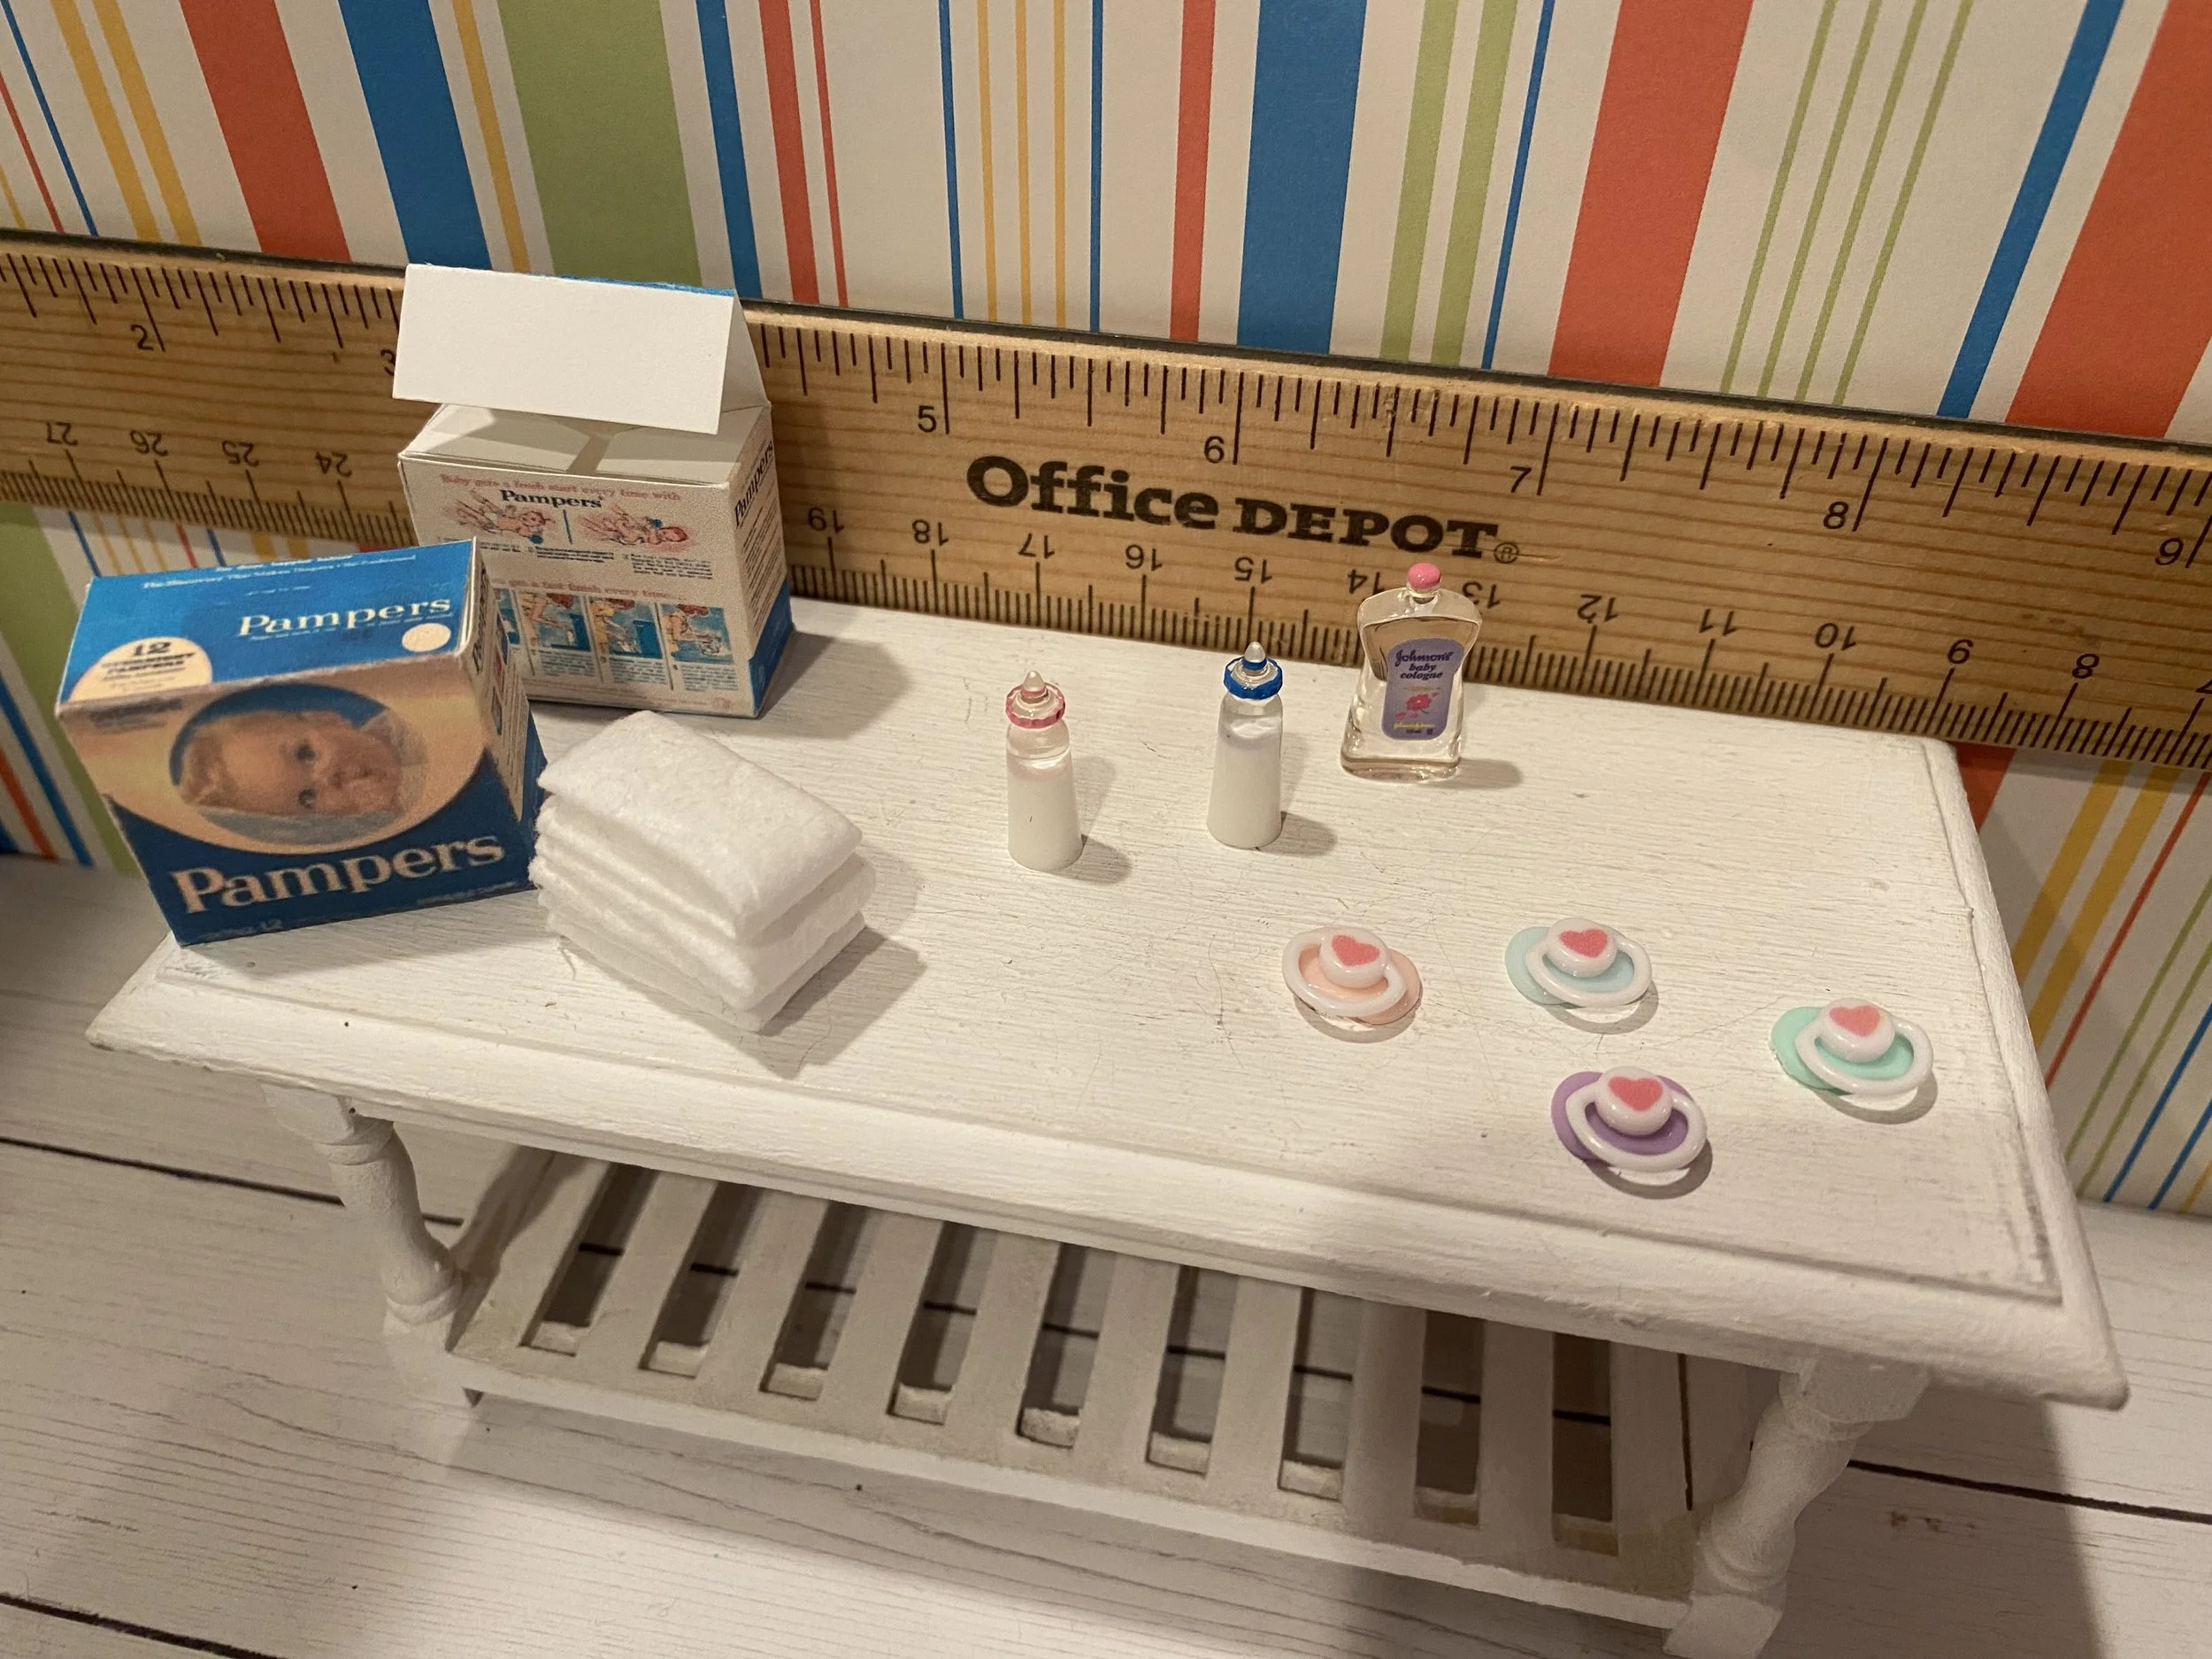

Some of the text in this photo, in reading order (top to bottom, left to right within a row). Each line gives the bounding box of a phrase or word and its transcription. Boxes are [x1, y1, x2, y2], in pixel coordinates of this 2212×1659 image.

[131, 325, 151, 351] 2
[918, 404, 937, 434] 5
[1203, 435, 1225, 465] 6
[1509, 465, 1532, 494] 7
[1823, 501, 1849, 530] 8
[2154, 537, 2185, 566] 9
[499, 488, 603, 509] Pampers
[735, 440, 773, 529] Pampers
[966, 455, 1219, 531] Office
[46, 421, 79, 447] 27
[129, 429, 169, 457] 26
[221, 440, 260, 467] 25
[315, 451, 352, 478] 24
[807, 507, 844, 533] 19
[911, 518, 949, 547] 18
[1018, 533, 1056, 559] 17
[1125, 544, 1163, 572] 16
[1234, 557, 1272, 584] 15
[1348, 569, 1386, 596] 14
[1462, 581, 1501, 610] 13
[1577, 594, 1618, 623] 12
[1699, 608, 1738, 637] 11
[1815, 622, 1857, 651] 10
[2071, 653, 2100, 680] 8
[238, 597, 452, 637] Pampers
[133, 641, 173, 657] 12
[1400, 671, 1444, 681] cologne
[1409, 663, 1437, 673] baby
[170, 834, 505, 914] Pampers
